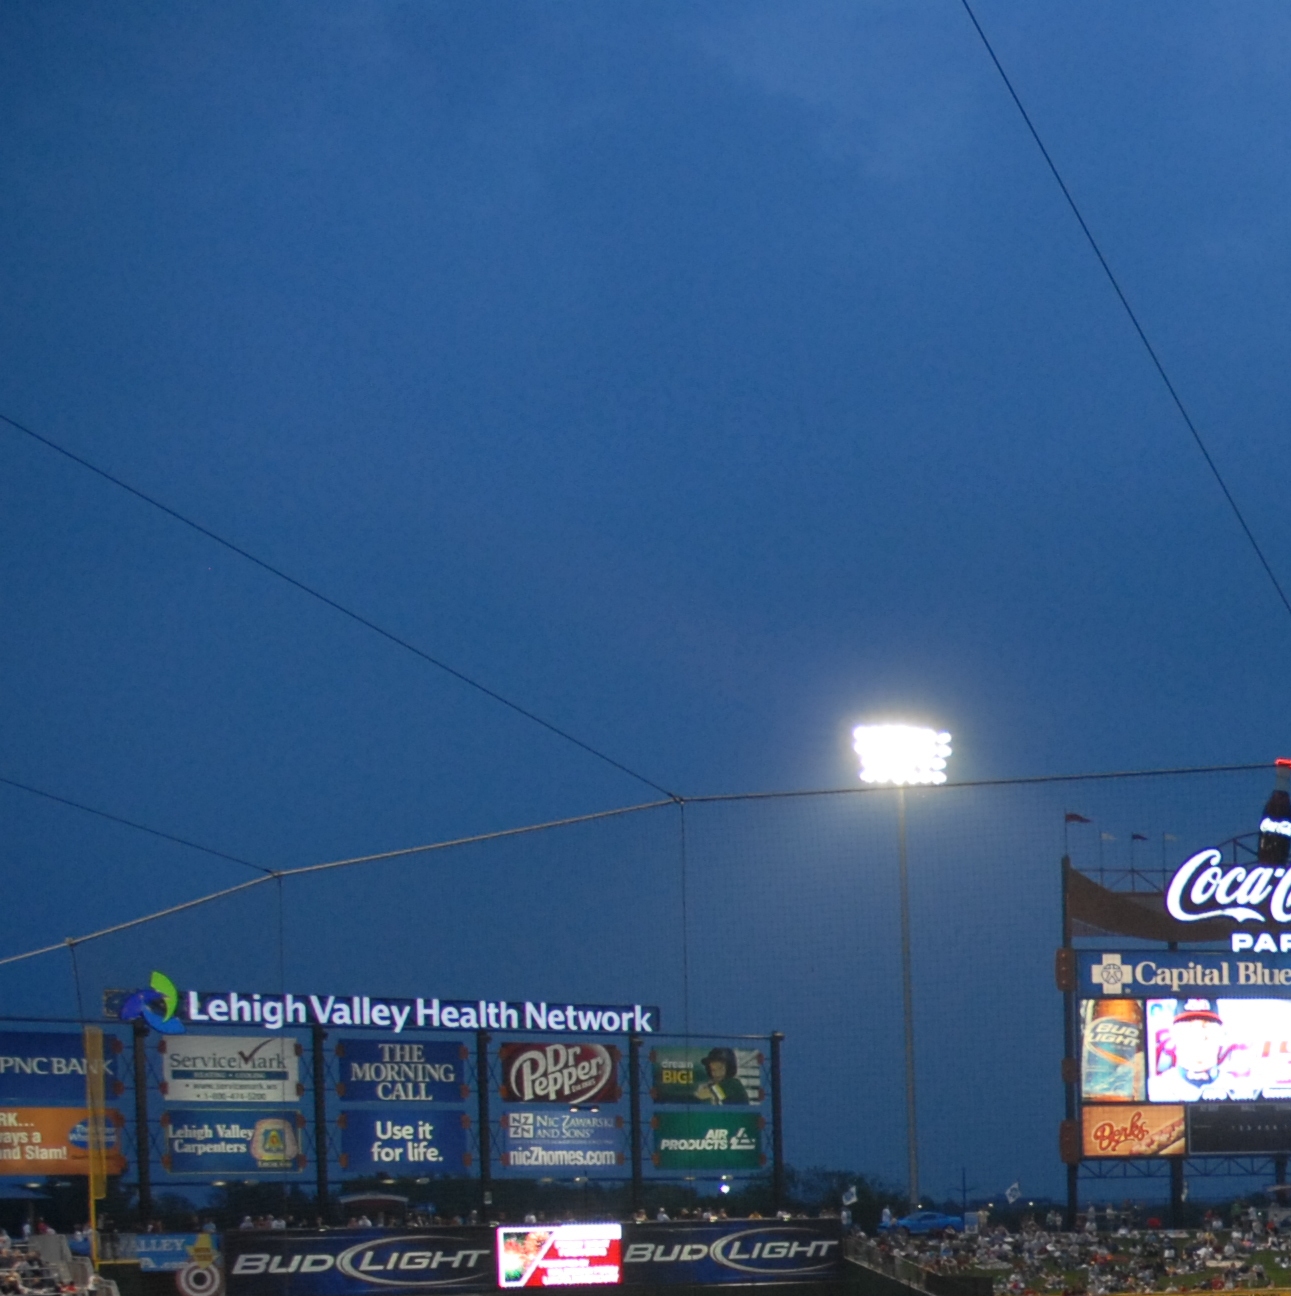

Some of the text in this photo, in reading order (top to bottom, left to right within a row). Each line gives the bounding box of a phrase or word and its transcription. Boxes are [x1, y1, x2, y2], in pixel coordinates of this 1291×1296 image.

[1134, 961, 1230, 990] Capital
[189, 992, 652, 1032] Lehigh Valley Health Network
[1096, 1023, 1138, 1036] BUD
[1088, 1033, 1140, 1047] LIGHT
[170, 1053, 286, 1070] ServiceMark
[379, 1044, 425, 1062] THE
[545, 1044, 581, 1071] Dr
[0, 1057, 48, 1074] PNC
[350, 1063, 455, 1082] MORNING
[522, 1050, 602, 1100] Pepper
[662, 1070, 694, 1083] BIG!
[377, 1082, 433, 1101] CALL
[169, 1123, 254, 1141] Lehigh Valley
[375, 1120, 433, 1140] Use it
[705, 1129, 728, 1140] AIR
[1094, 1111, 1148, 1151] Berks
[173, 1141, 247, 1156] Carpenters
[372, 1143, 443, 1162] for life.
[660, 1139, 729, 1150] PRODUCTS
[510, 1147, 616, 1167] nicZhomes.com
[624, 1243, 711, 1263] BUD
[729, 1240, 838, 1259] LIGHT
[232, 1250, 491, 1275] BUD LIGHT
